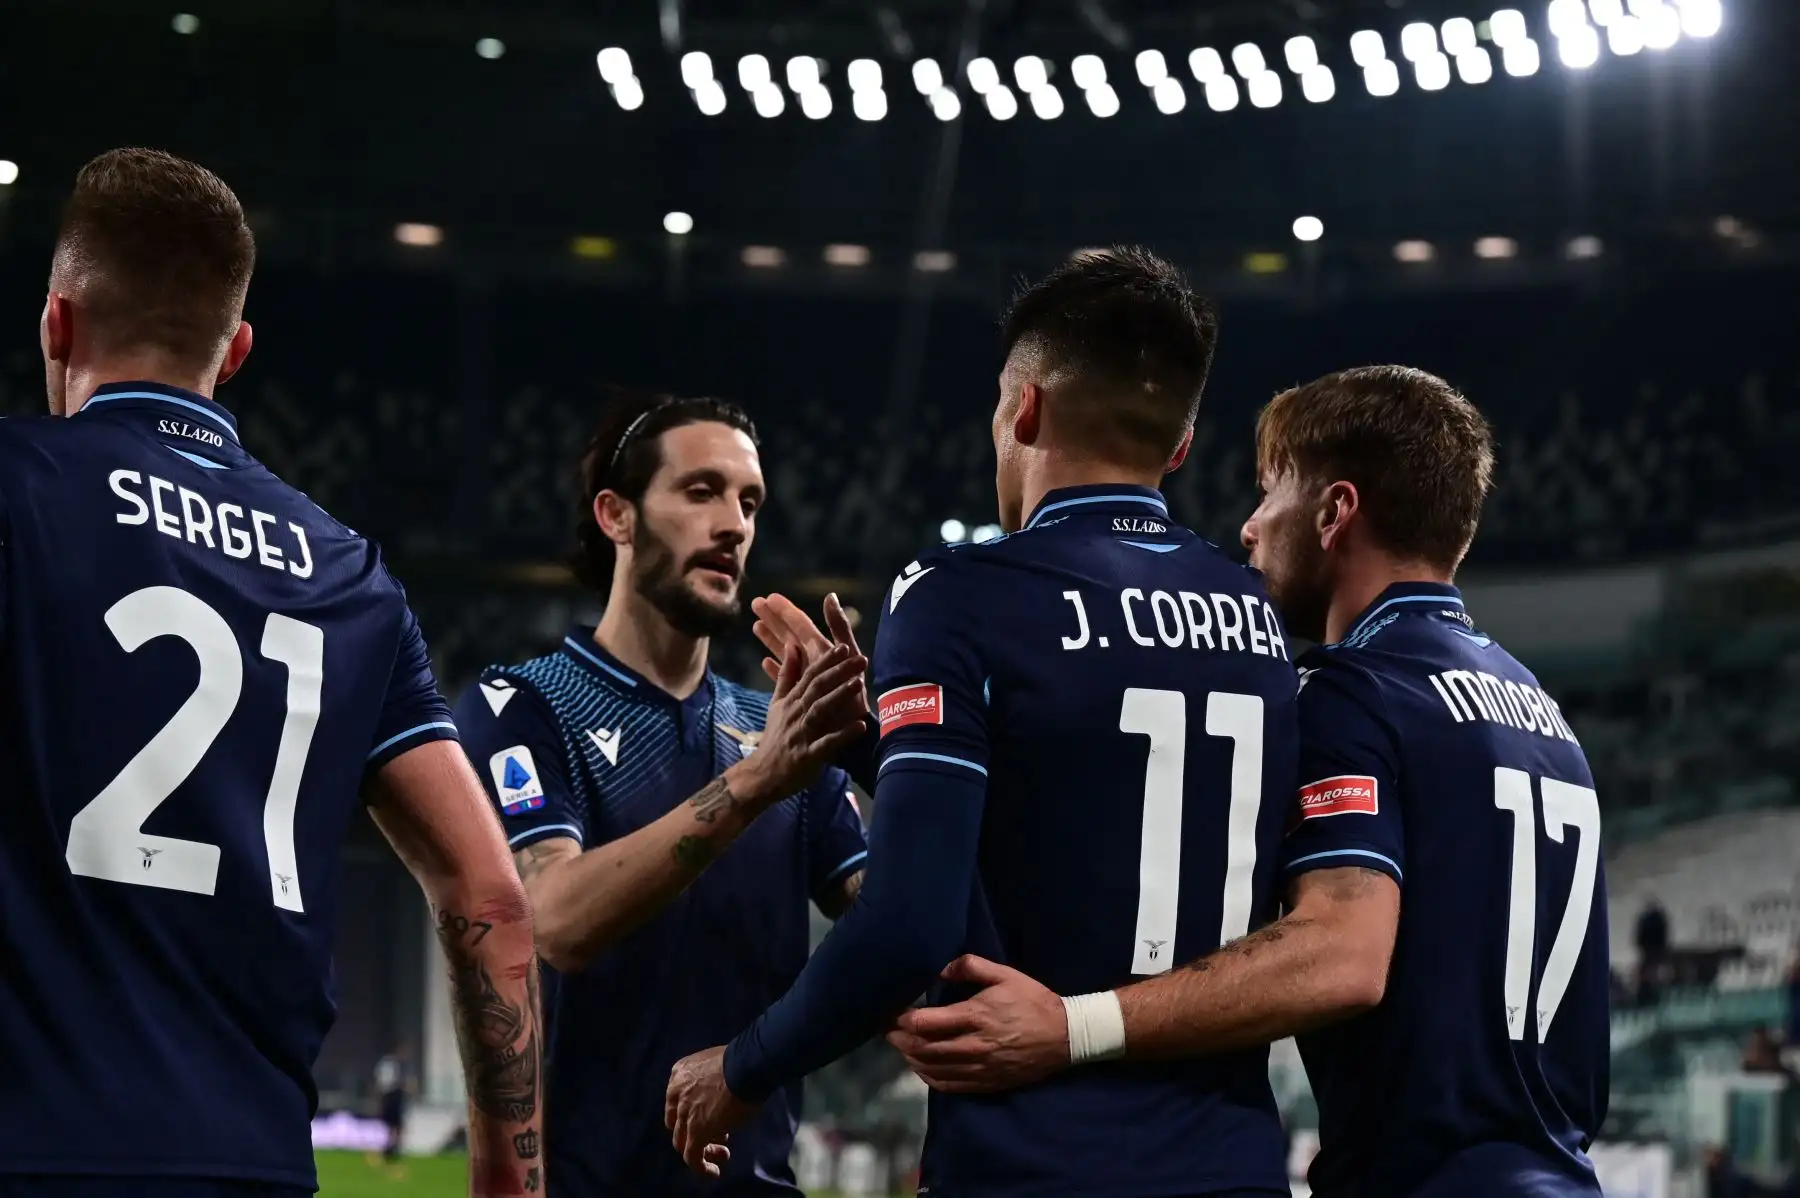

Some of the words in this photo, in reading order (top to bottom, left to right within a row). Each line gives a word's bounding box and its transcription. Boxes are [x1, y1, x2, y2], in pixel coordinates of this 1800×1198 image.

[108, 469, 313, 579] SERGEJ
[1061, 590, 1109, 651] J.
[1120, 587, 1289, 662] CORREA
[1428, 669, 1581, 748] IMMOBIL
[66, 585, 324, 913] 21
[1119, 687, 1264, 975] 11
[1494, 766, 1601, 1045] 17
